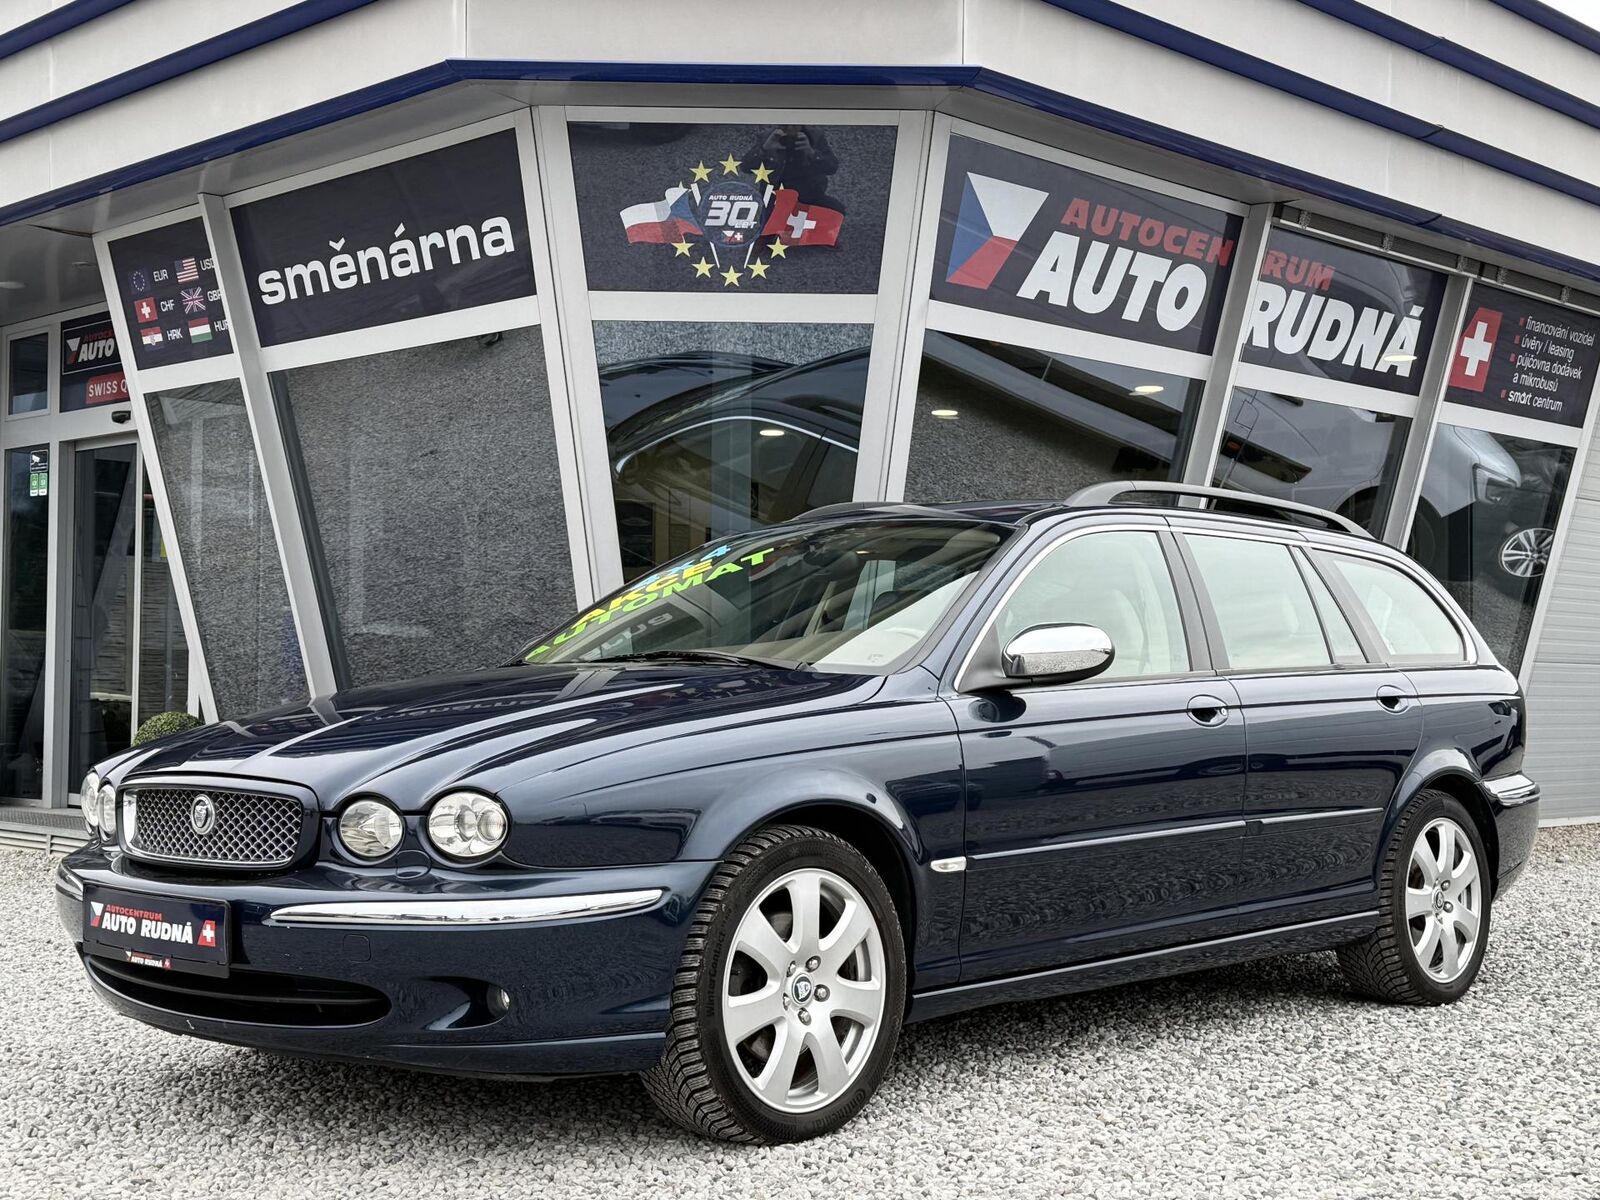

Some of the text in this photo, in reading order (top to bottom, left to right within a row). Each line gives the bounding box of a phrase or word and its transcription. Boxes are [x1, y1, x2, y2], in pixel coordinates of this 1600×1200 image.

[704, 200, 759, 227] 30
[257, 216, 516, 305] směnárna
[153, 269, 169, 282] EUR
[160, 299, 175, 312] CHF
[1016, 230, 1425, 378] AUTO RUDNÁ
[166, 327, 183, 341] HRK
[1525, 315, 1596, 347] financování vozidel
[77, 338, 115, 363] AUTO
[1521, 333, 1543, 355] úvěry
[1547, 340, 1575, 363] leasing
[1512, 372, 1519, 383] a
[1551, 360, 1583, 380] dodávek
[88, 380, 118, 397] SWISS
[1507, 390, 1563, 412] smart centrum
[525, 547, 775, 660] AUTOMAT
[571, 558, 713, 629] AKCE
[105, 903, 163, 921] AUTOCENTRUM
[101, 912, 194, 945] AUTO RUDNÁ
